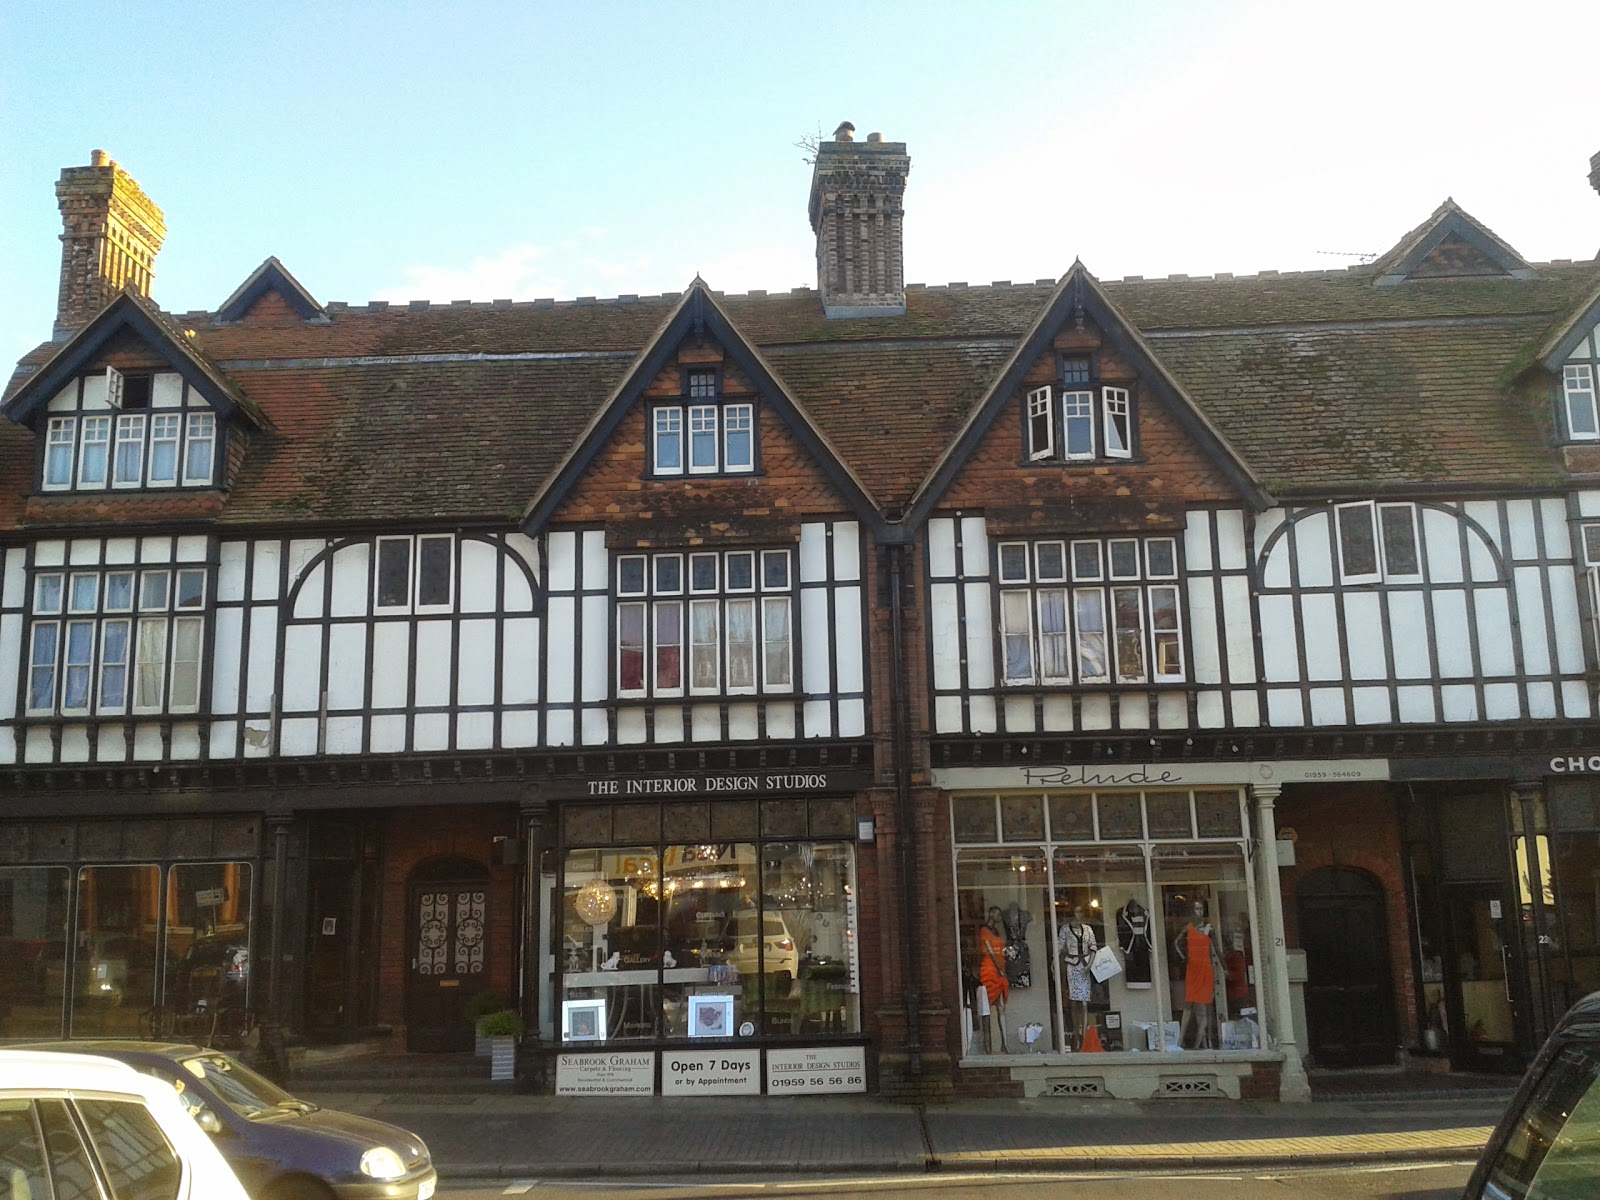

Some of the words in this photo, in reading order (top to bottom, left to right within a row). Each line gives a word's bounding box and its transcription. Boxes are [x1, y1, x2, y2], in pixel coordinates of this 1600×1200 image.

[1020, 764, 1182, 785] Prelude
[588, 780, 619, 795] THE
[626, 778, 697, 793] INTERIOR
[705, 776, 759, 791] DESIGN
[766, 774, 827, 789] STUDIOS
[1275, 937, 1284, 947] 21
[1539, 935, 1549, 944] 23
[561, 1055, 607, 1066] SEABROOK
[609, 1055, 650, 1066] GRAHAM
[671, 1061, 704, 1074] Open
[709, 1060, 716, 1071] 7
[721, 1060, 751, 1073] Days
[772, 1062, 803, 1071] INTERIOR
[833, 1061, 861, 1069] STUDIOS
[686, 1077, 695, 1087] by
[698, 1077, 747, 1086] Appointment
[771, 1078, 805, 1087] 01959
[809, 1077, 824, 1086] 56
[828, 1077, 843, 1085] 56
[847, 1076, 862, 1085] 86
[559, 1085, 651, 1094] www.seabrookgraham.com
